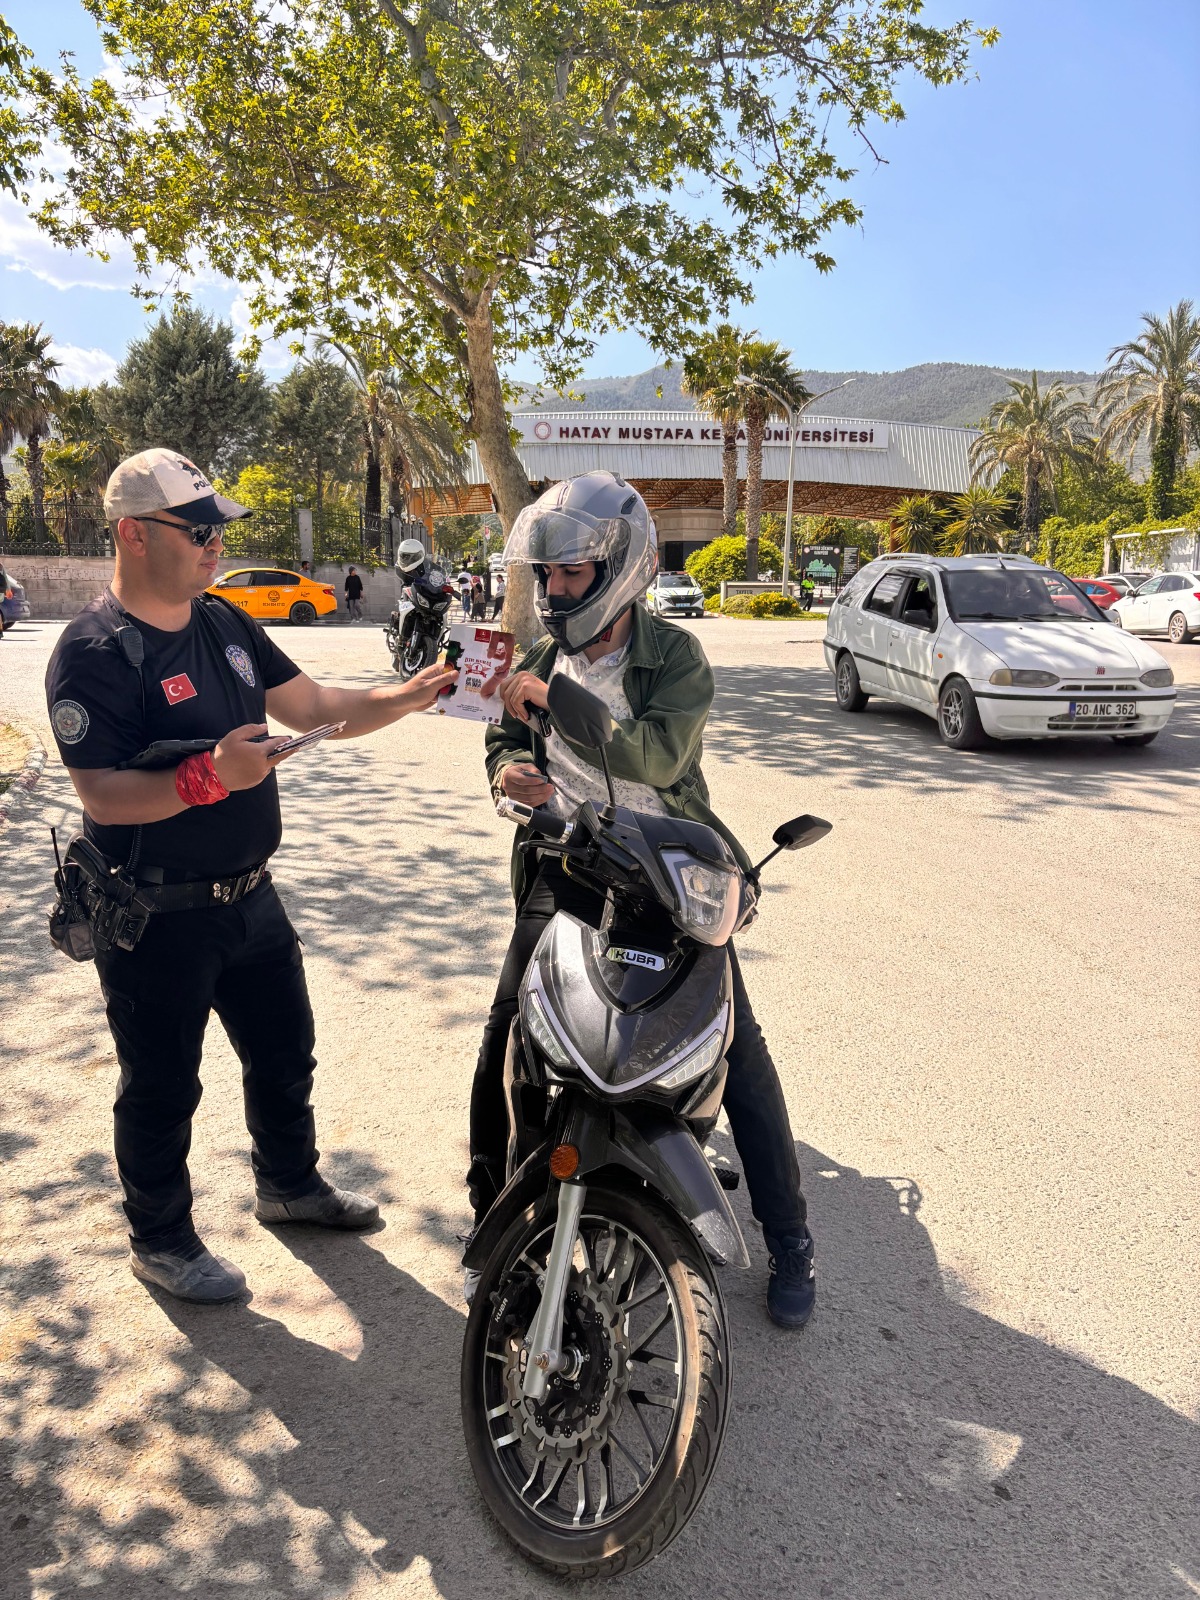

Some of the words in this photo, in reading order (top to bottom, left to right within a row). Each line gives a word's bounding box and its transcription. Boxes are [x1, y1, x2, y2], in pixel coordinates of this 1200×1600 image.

[559, 426, 611, 439] HATAY
[618, 427, 694, 440] MUSTAFA
[700, 428, 752, 440] KEA
[193, 480, 211, 491] POL
[1076, 703, 1089, 715] 20
[1092, 703, 1112, 715] ANC
[1115, 703, 1135, 715] 362
[615, 950, 657, 967] KUBA
